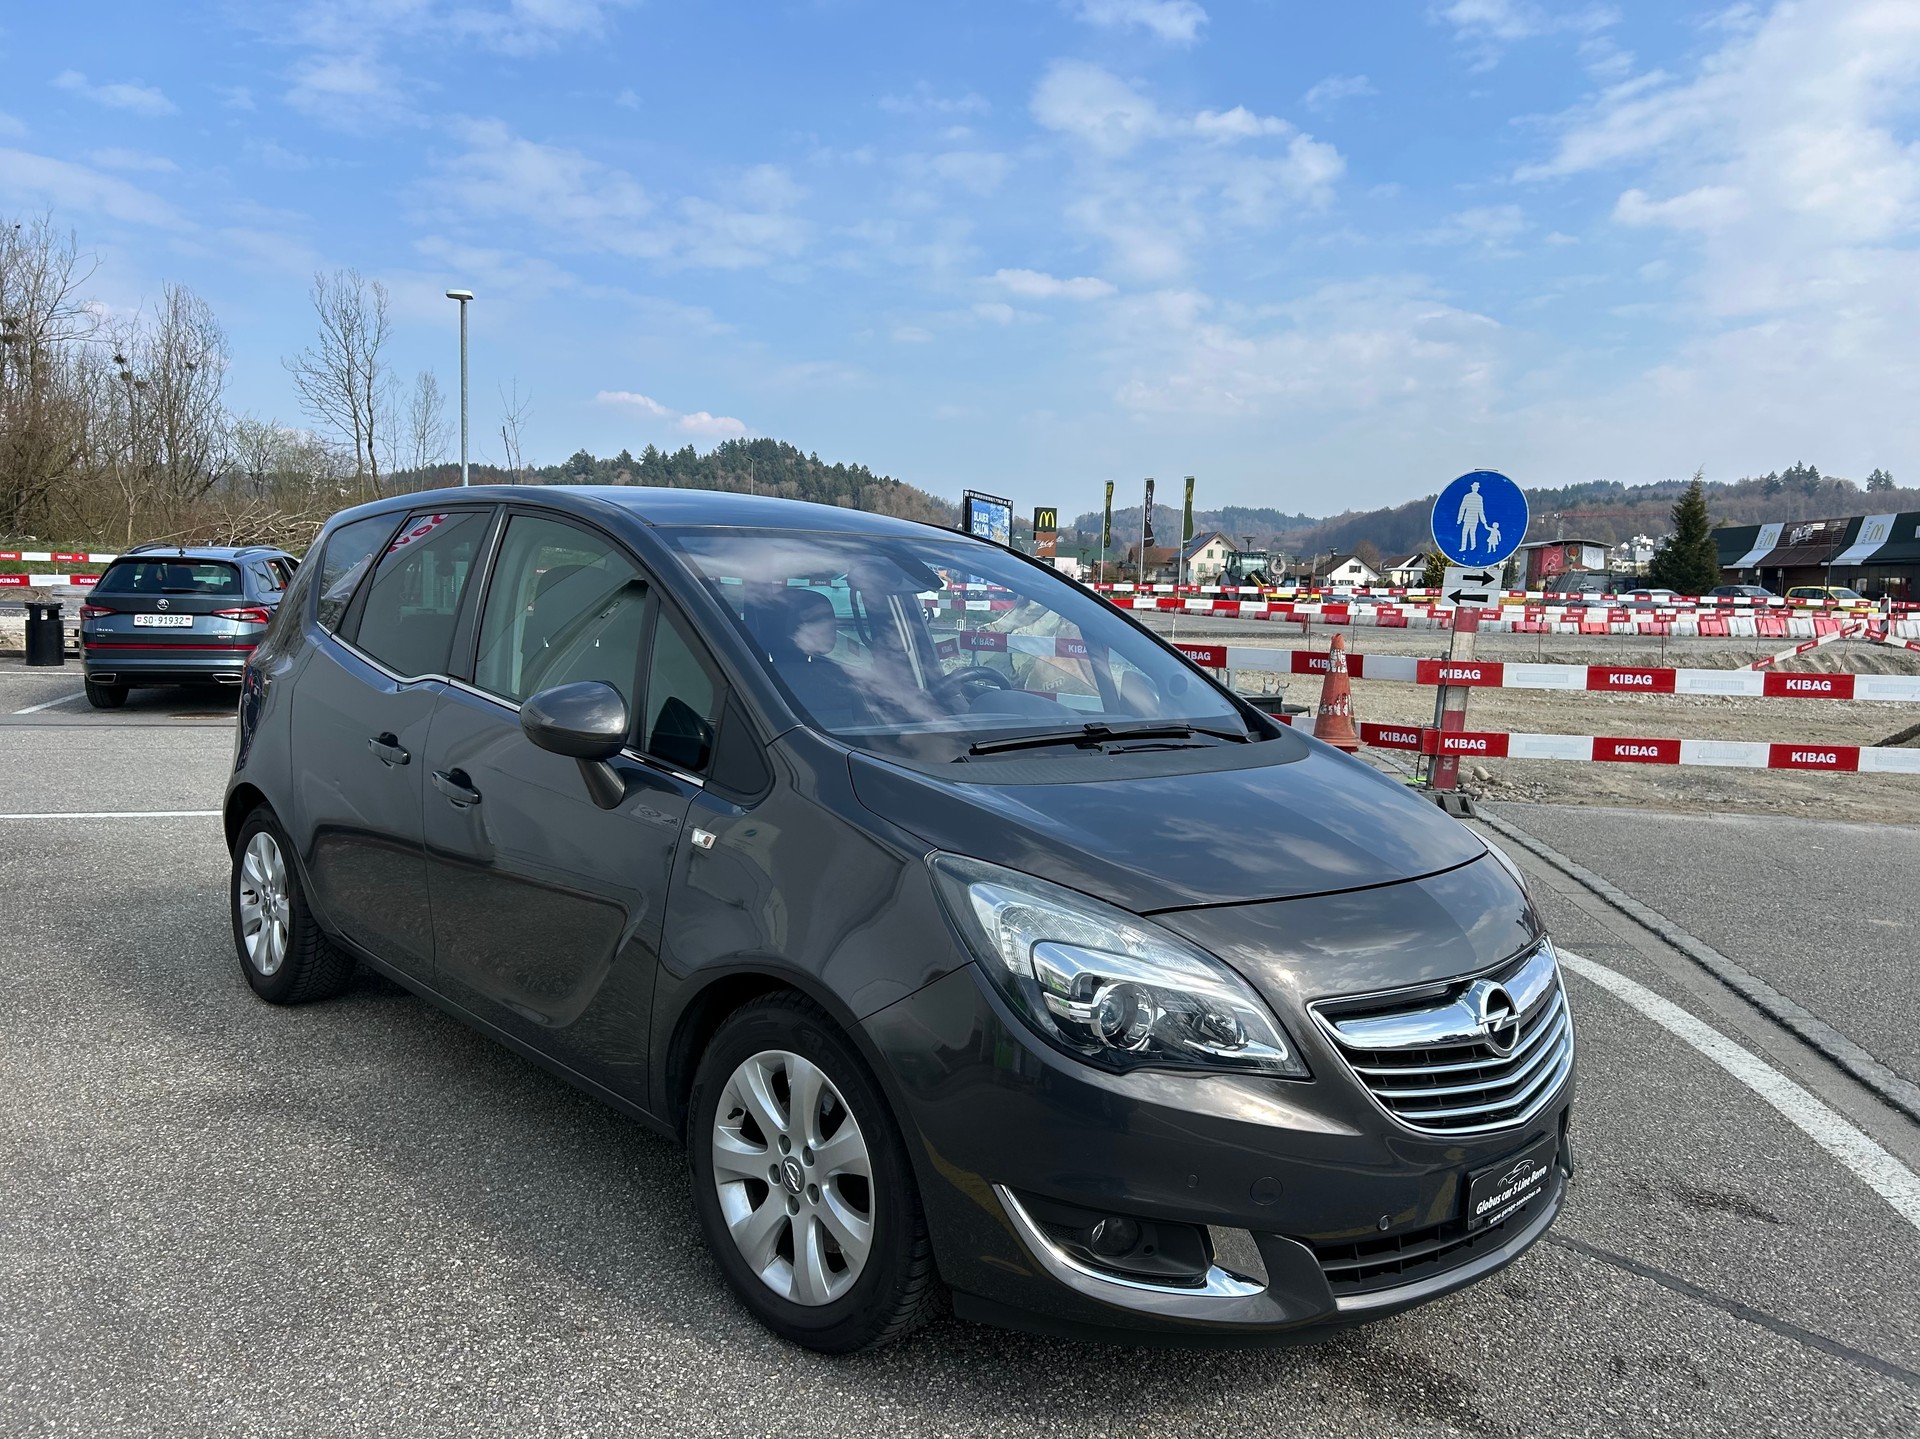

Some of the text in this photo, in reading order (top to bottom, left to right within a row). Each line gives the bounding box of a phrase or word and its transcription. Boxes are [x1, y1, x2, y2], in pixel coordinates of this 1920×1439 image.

[974, 511, 988, 523] BLAUER
[974, 522, 989, 536] SALON
[971, 636, 995, 646] KBAG
[1068, 644, 1087, 653] KIBA
[1309, 658, 1330, 668] KIB
[1439, 668, 1481, 679] KIBAG
[1610, 674, 1652, 685] KIBAG
[1786, 680, 1831, 691] KIBAG
[1379, 731, 1417, 743] KIBAG
[1444, 738, 1486, 750] KIBAG
[1615, 745, 1658, 756] KIBAG
[1791, 752, 1836, 763] KIBAG
[1476, 1194, 1501, 1215] Globus
[1501, 1188, 1513, 1201] car
[1512, 1182, 1518, 1194] S
[1517, 1177, 1531, 1192] Line
